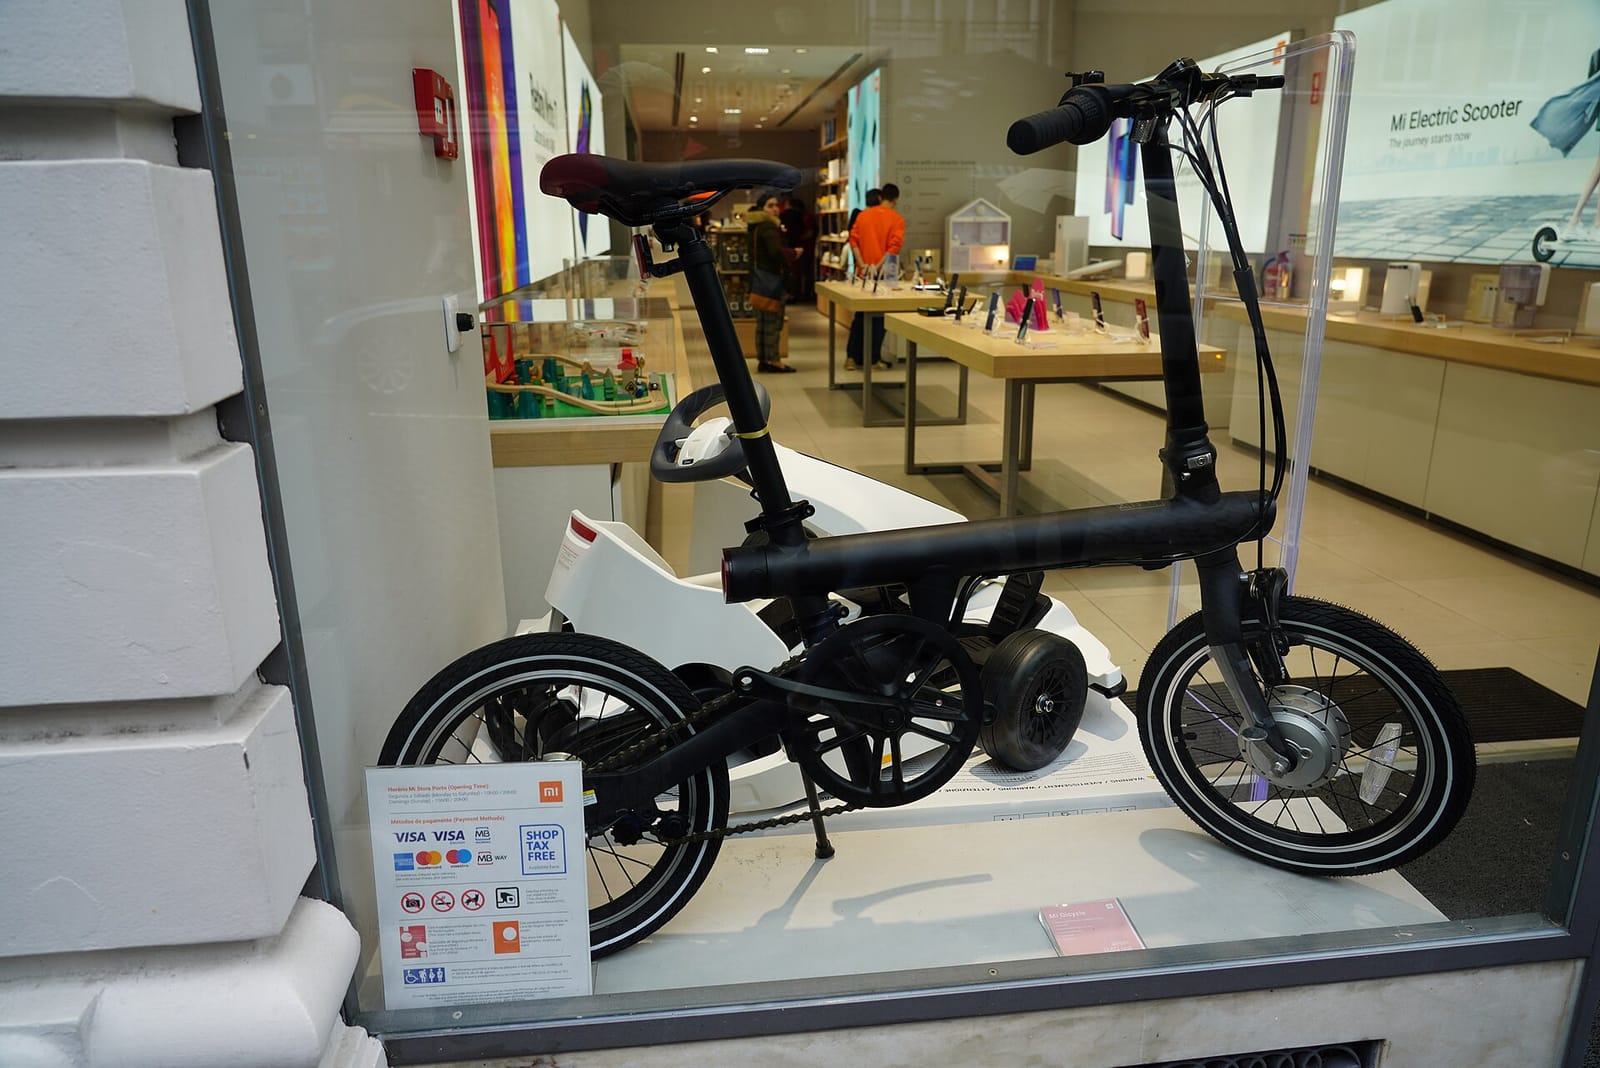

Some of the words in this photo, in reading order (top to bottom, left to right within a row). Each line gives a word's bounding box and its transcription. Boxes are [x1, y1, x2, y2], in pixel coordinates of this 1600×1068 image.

[1391, 113, 1407, 132] Mi
[1409, 106, 1459, 129] Electric
[1462, 99, 1523, 122] Scooter
[1390, 138, 1402, 148] The
[1403, 136, 1429, 149] journey
[1430, 133, 1452, 144] starts
[1453, 132, 1471, 141] now
[393, 831, 427, 843] VISA
[431, 829, 465, 841] VISA
[475, 829, 490, 838] MB
[526, 830, 559, 840] SHOP
[526, 841, 549, 851] TAX
[477, 854, 493, 862] MB
[528, 851, 556, 861] FREE
